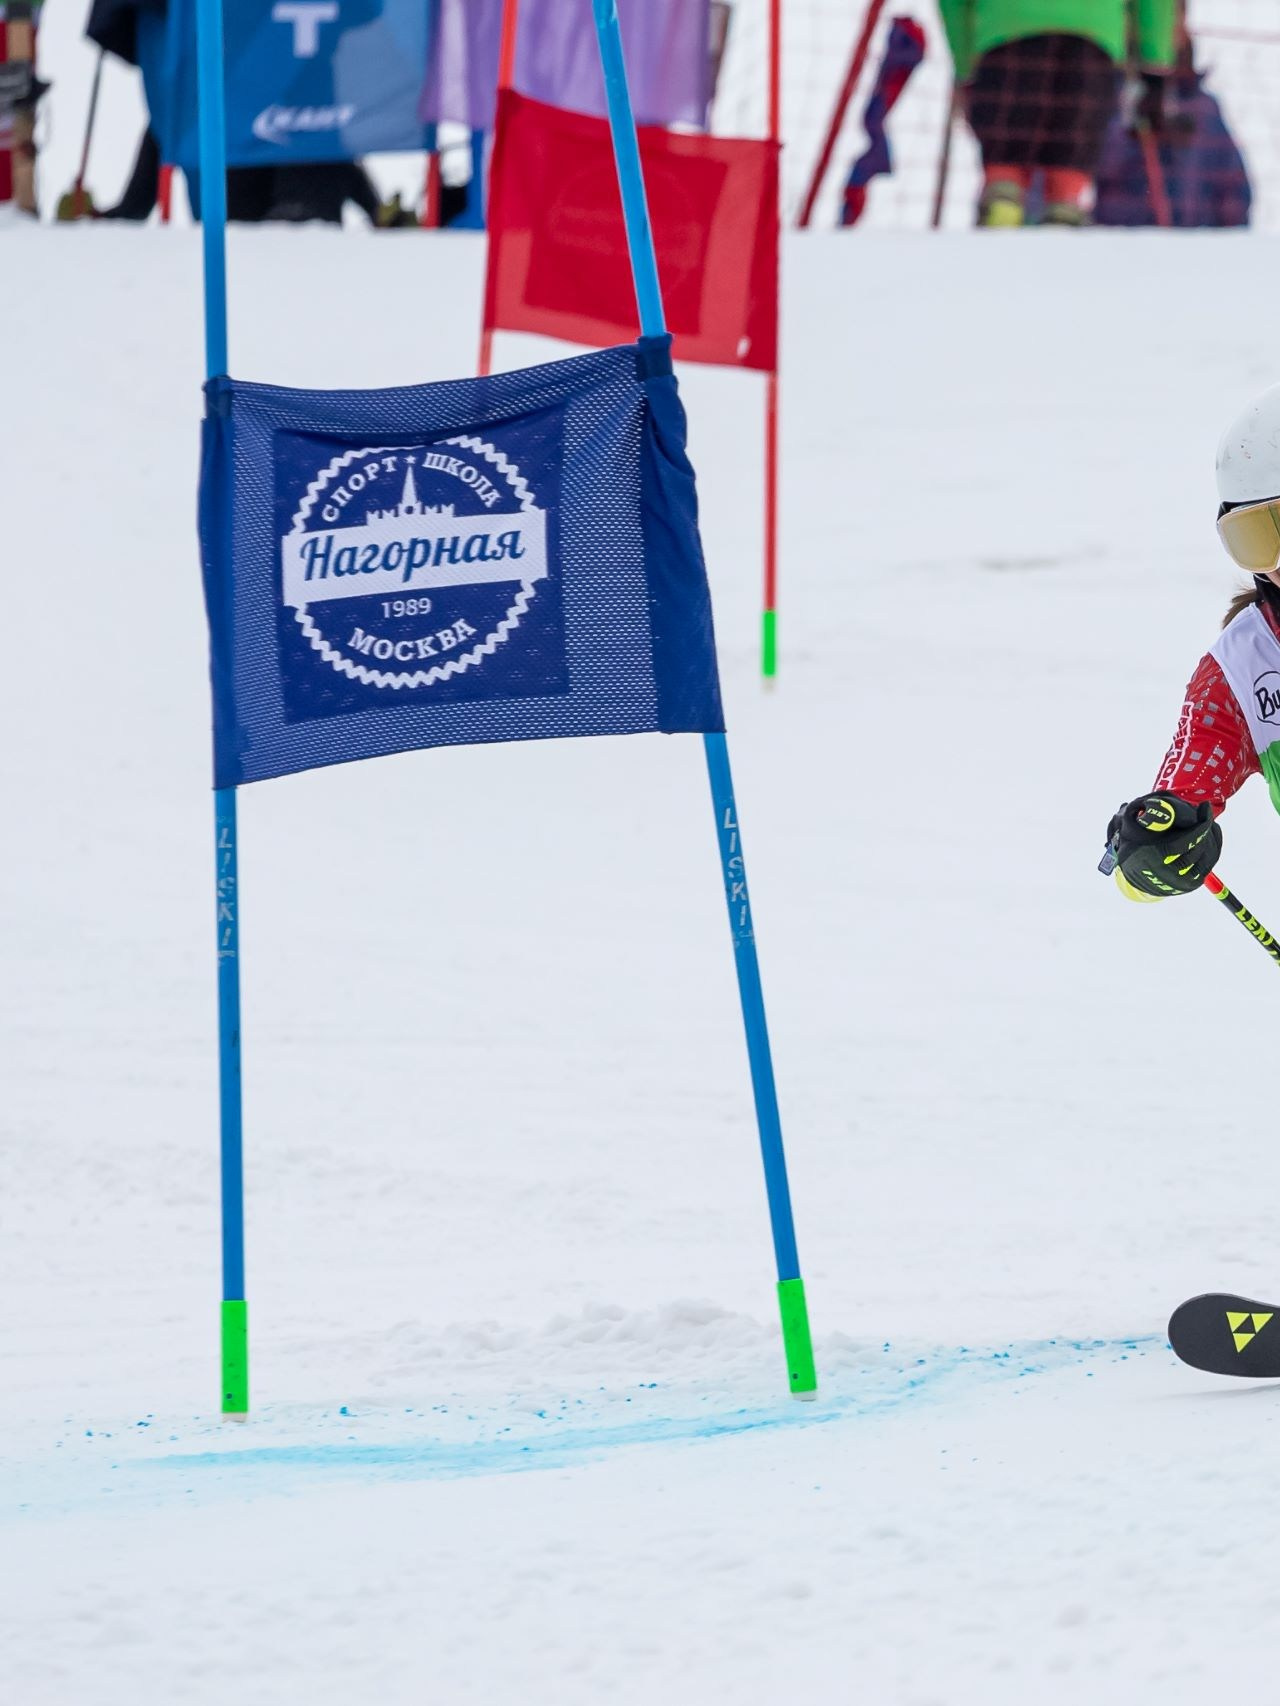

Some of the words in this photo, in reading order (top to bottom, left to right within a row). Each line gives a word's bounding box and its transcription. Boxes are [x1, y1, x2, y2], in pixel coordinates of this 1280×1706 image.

[321, 455, 398, 522] СПОРТ
[421, 451, 502, 508] ШКОЛА
[299, 529, 526, 583] Нагорная
[381, 597, 432, 618] 1989
[347, 618, 478, 661] МОСКВА
[723, 807, 749, 927] LISKI
